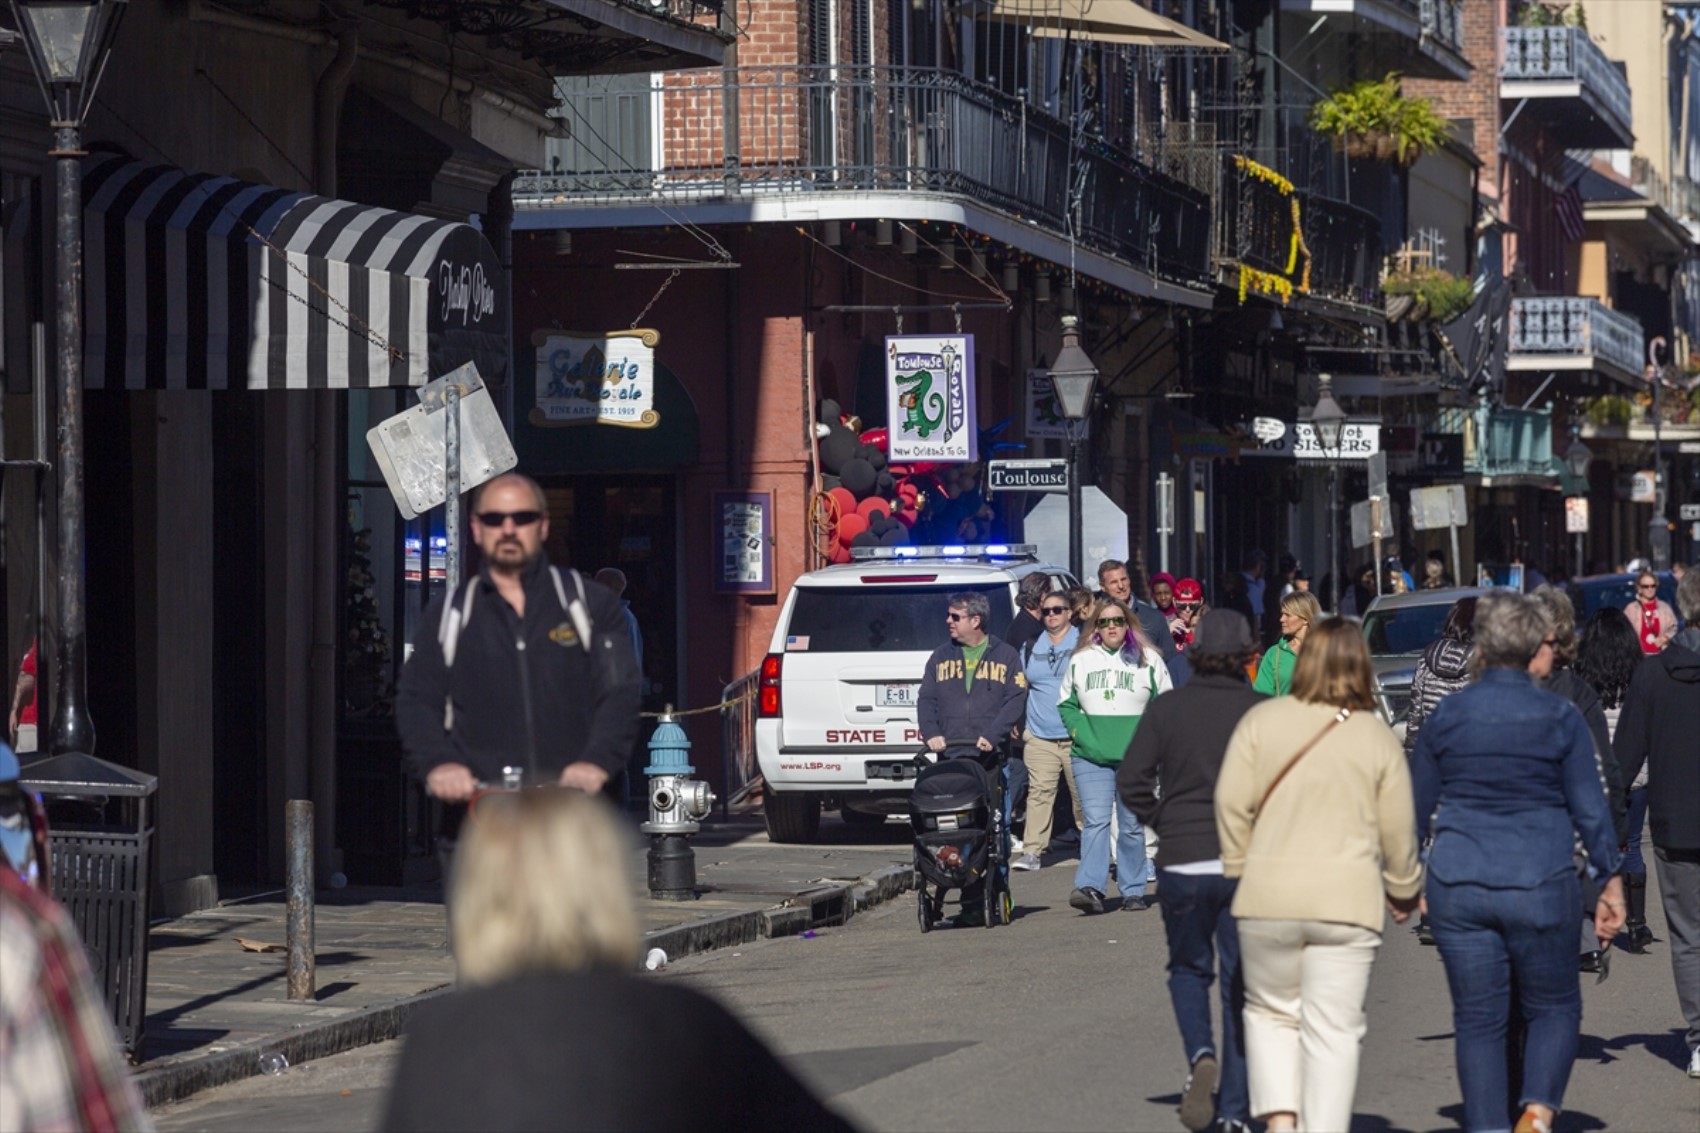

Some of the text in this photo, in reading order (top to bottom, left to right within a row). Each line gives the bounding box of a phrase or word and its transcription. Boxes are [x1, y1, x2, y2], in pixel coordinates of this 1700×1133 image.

[897, 357, 943, 369] Toulouse
[583, 383, 643, 400] Roale
[950, 359, 963, 428] Royale
[550, 406, 571, 415] FINE
[1293, 439, 1372, 452] SISERS
[992, 469, 1065, 485] Toulouse
[886, 688, 910, 700] E-81
[826, 730, 886, 743] STATE
[780, 762, 842, 771] www.LSP.org
